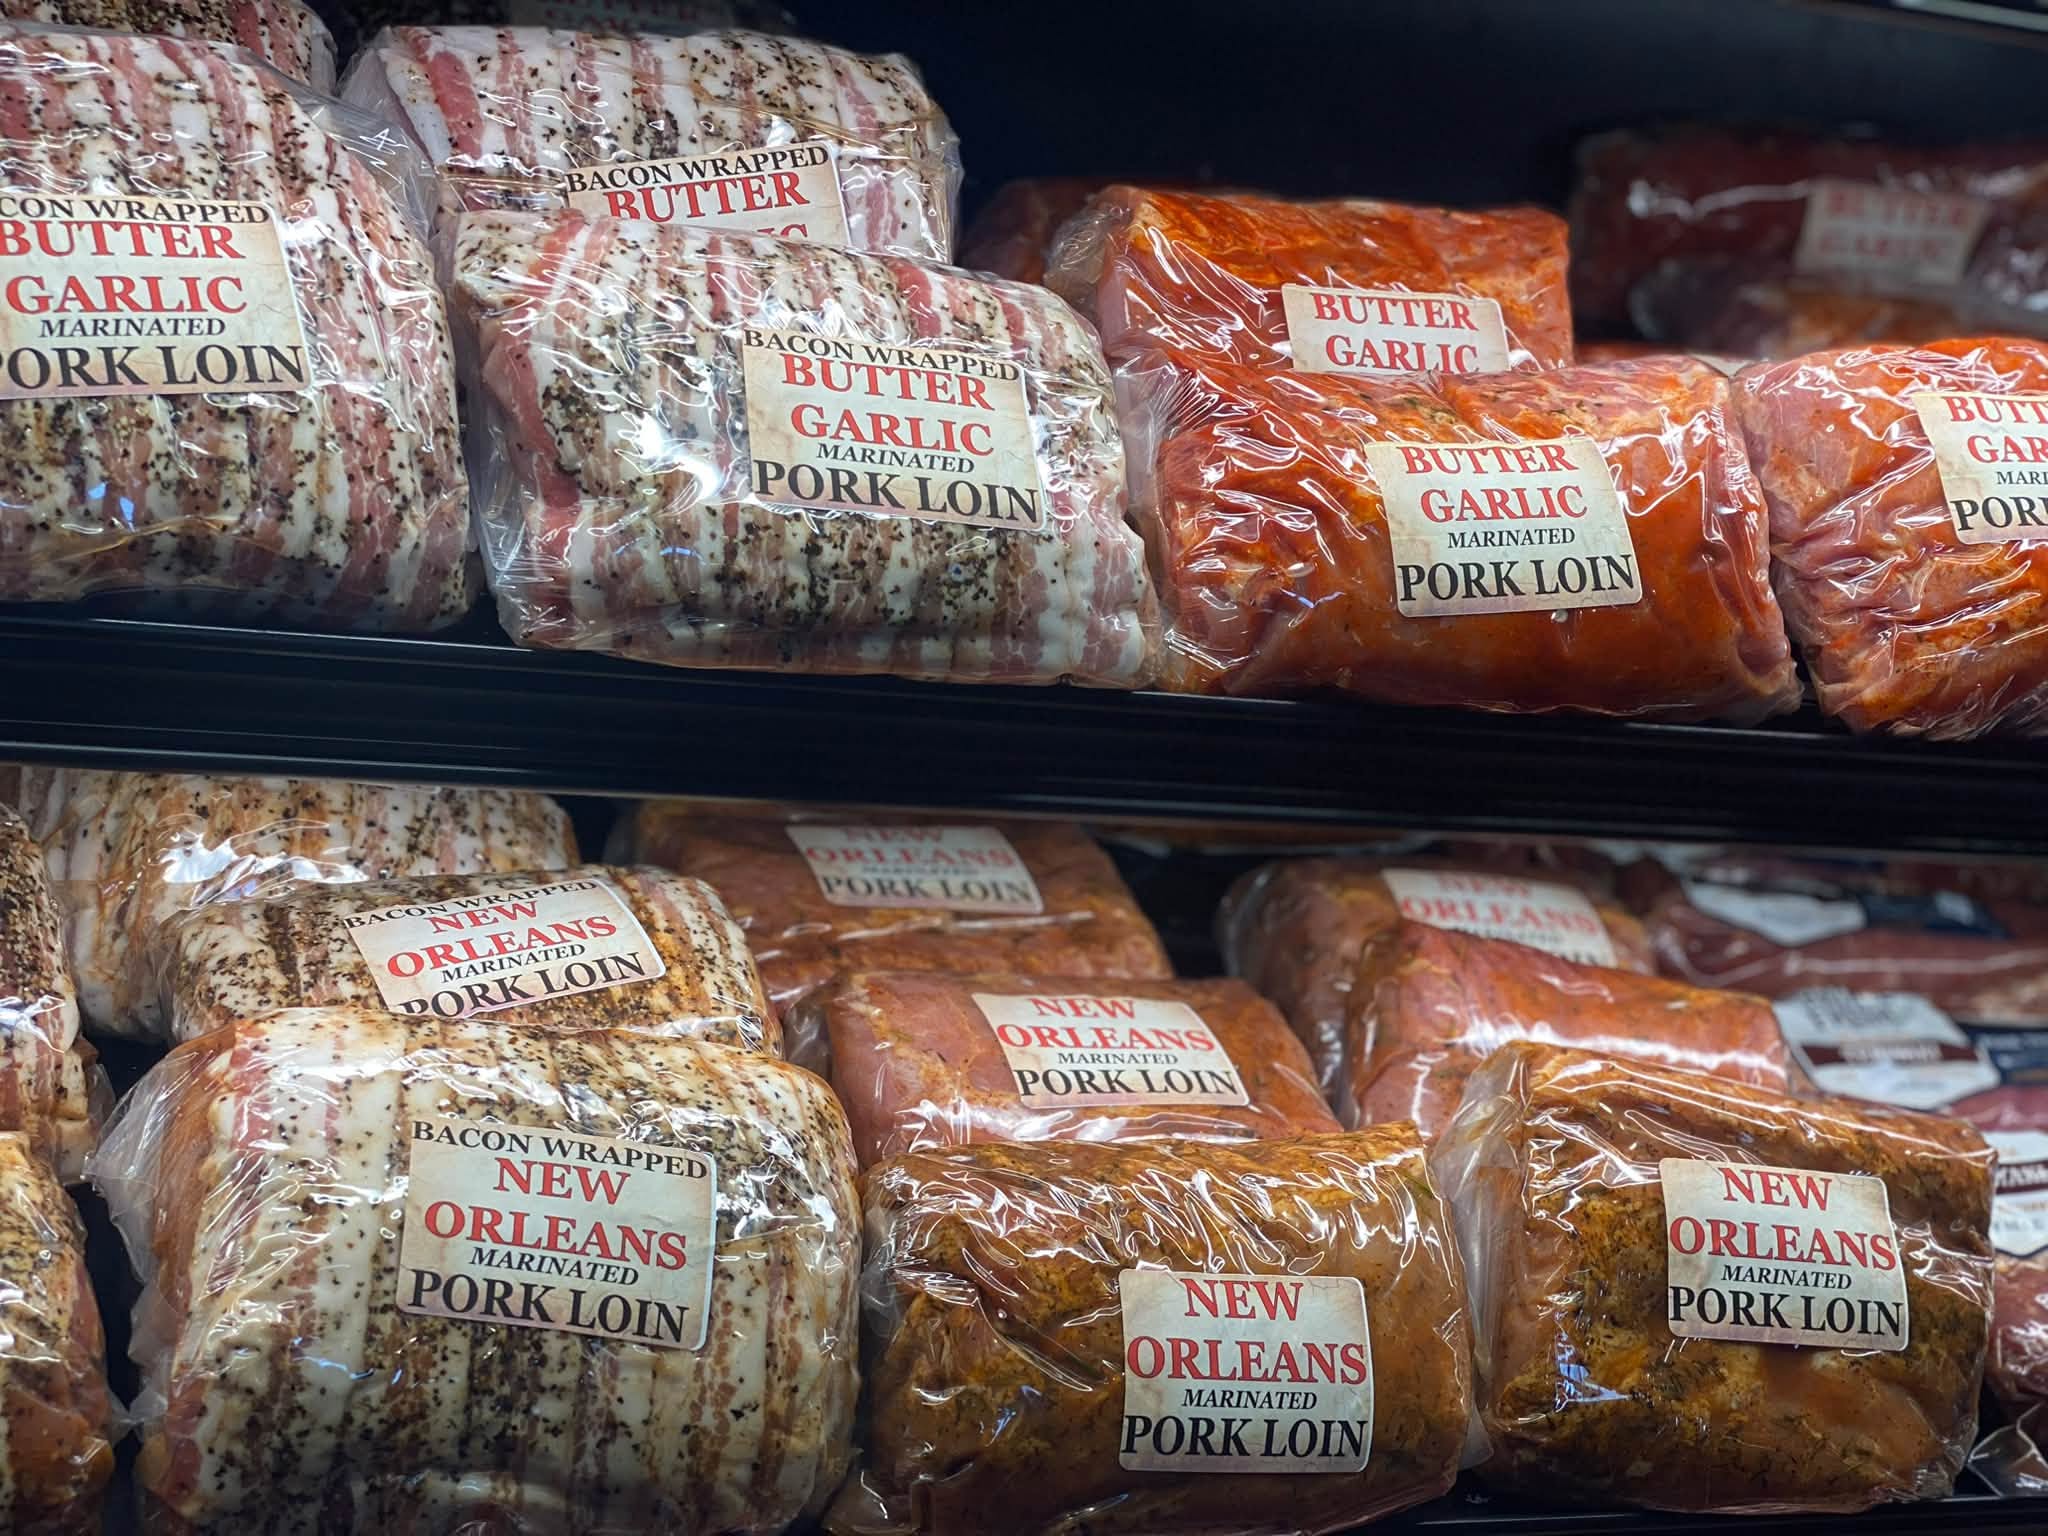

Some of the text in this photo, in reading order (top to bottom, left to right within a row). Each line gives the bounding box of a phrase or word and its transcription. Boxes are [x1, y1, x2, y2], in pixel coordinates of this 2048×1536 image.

[565, 146, 828, 192] BACON WRAPPED
[84, 199, 269, 223] WRAPPED
[603, 171, 810, 222] BUTTER
[0, 220, 246, 259] BUTTER
[6, 275, 247, 314] GARLIC
[1310, 293, 1479, 331] BUTTER
[38, 318, 226, 338] MARINATED
[0, 345, 304, 389] ORK LOIN
[744, 329, 1020, 381] BACON WRAPPED
[1326, 335, 1480, 374] GARLIC
[780, 353, 994, 411] BUTTER
[791, 404, 994, 456] GARLIC
[817, 443, 974, 473] MARINATED
[1396, 444, 1579, 474] BUTTER
[753, 459, 1038, 523] PORK LOIN
[1420, 485, 1587, 522] GARLIC
[1448, 528, 1575, 548] MARINATED
[1397, 554, 1634, 601] PORK LOIN
[343, 880, 598, 928] BACON WRAPPED
[822, 876, 1035, 903] PORK LOIN
[424, 901, 537, 934] NEW
[387, 915, 617, 978] ORLEANS
[441, 944, 586, 983] MARINATED
[537, 952, 647, 995] LOIN
[1028, 998, 1136, 1020] NEW
[996, 1024, 1215, 1051] ORLEANS
[1058, 1052, 1178, 1065] MARINATED
[1013, 1068, 1239, 1096] PORK LOIN
[413, 1120, 708, 1179] BACON WRAPPED
[493, 1157, 631, 1205] NEW
[1718, 1167, 1832, 1211] NEW
[424, 1200, 687, 1271] ORLEANS
[1669, 1216, 1897, 1271] ORLEANS
[469, 1246, 639, 1286] MARINATED
[1721, 1264, 1852, 1290] MARINATED
[407, 1268, 689, 1343] PORK LOIN
[1180, 1278, 1304, 1321] NEW
[1669, 1285, 1904, 1337] PORK LOIN
[1127, 1336, 1368, 1385] ORLEANS
[1181, 1388, 1318, 1410] MARINATED
[1120, 1415, 1368, 1458] PORK LOIN
